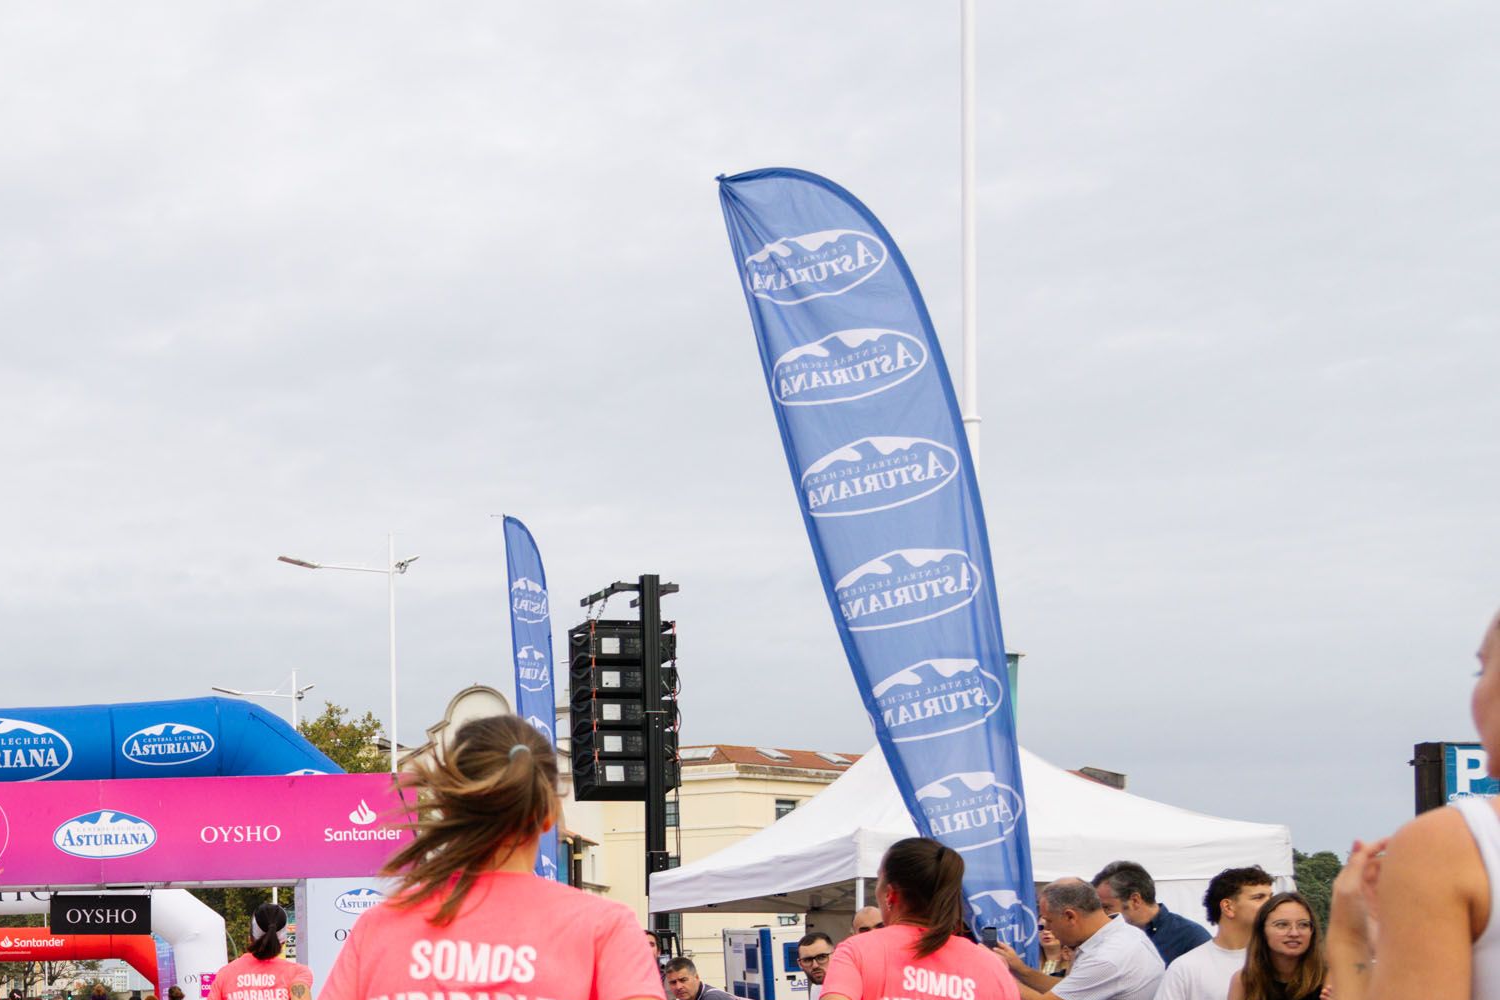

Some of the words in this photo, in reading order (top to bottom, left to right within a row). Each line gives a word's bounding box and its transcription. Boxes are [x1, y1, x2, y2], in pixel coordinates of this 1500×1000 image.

[0, 736, 54, 746] LECHERA
[130, 737, 208, 758] ASTURIANA
[1456, 748, 1489, 794] P
[62, 828, 149, 848] ASTURIANA
[200, 824, 281, 844] OYSHO
[324, 826, 402, 842] Santander
[340, 898, 376, 909] ASTURI
[65, 908, 138, 925] OYSHO
[13, 937, 65, 948] Santander
[409, 939, 537, 984] SOMOS
[237, 973, 276, 988] SOMOS
